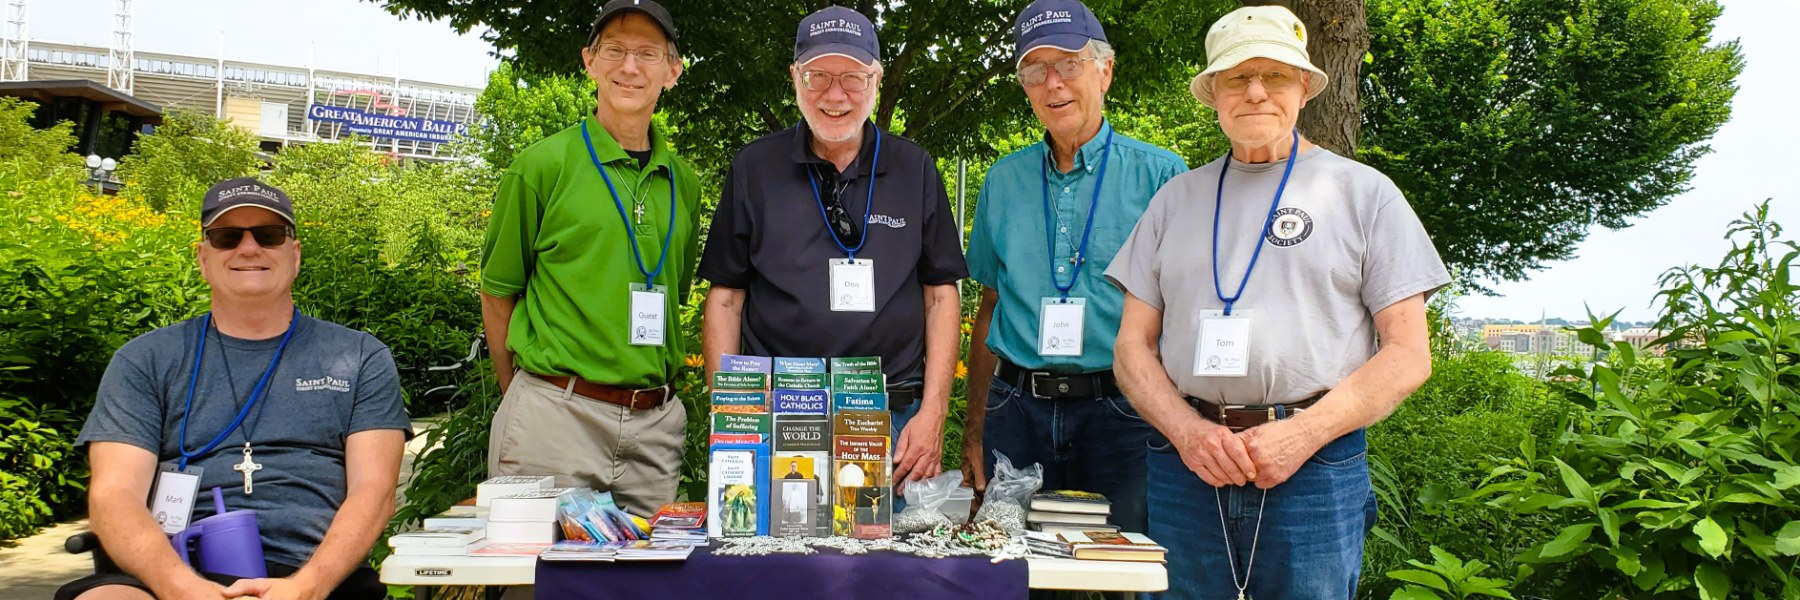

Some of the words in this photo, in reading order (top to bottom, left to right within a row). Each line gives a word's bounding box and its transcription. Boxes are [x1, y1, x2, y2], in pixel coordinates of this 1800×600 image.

[810, 20, 836, 32] SAINT
[839, 18, 862, 32] PAUL
[1021, 13, 1043, 32] SAINT
[1045, 10, 1071, 19] PAUL
[312, 106, 358, 121] GREAT
[352, 113, 418, 130] AMERICAN
[422, 120, 453, 133] BALL
[396, 130, 427, 139] AMERICAN
[218, 185, 250, 198] SAINT
[253, 184, 279, 200] PAUL
[864, 214, 887, 223] AINT
[887, 216, 905, 226] PAUL
[1294, 210, 1311, 225] PAUL
[1267, 234, 1303, 246] SOCIETY
[639, 311, 658, 320] Guest
[1216, 339, 1234, 347] Tom
[295, 378, 325, 387] SAINT
[326, 375, 350, 387] PAUL
[845, 396, 874, 405] Fatima
[780, 402, 824, 410] CATHOLICS
[733, 423, 759, 431] Suffering
[782, 432, 821, 440] WORLD
[841, 452, 860, 460] HOLY
[861, 452, 880, 460] MASS
[166, 495, 184, 504] Mark
